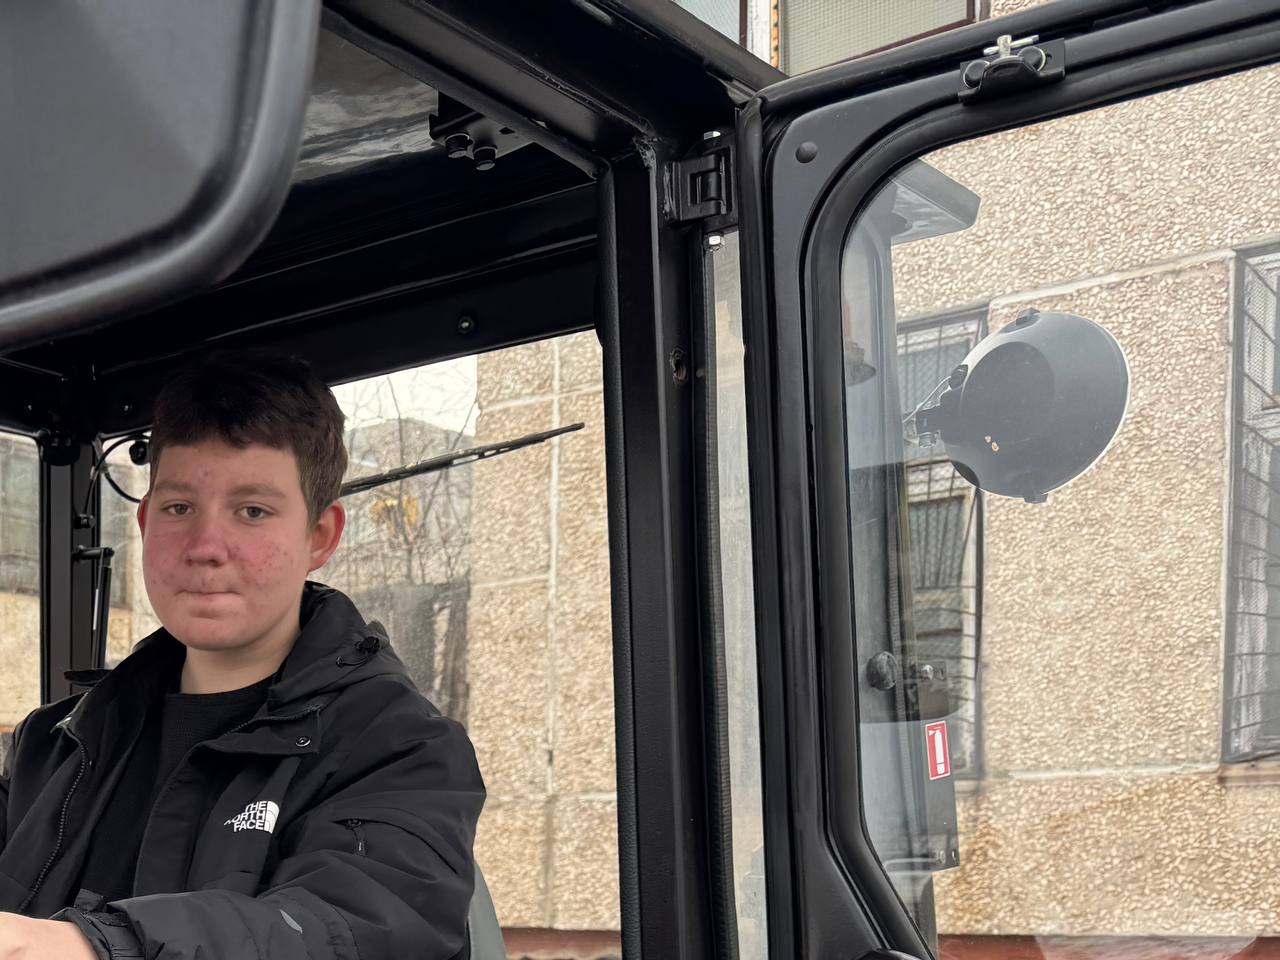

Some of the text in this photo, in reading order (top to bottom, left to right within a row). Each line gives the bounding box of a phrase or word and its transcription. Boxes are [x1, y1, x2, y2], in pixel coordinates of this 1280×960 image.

[245, 800, 267, 813] THE
[223, 810, 266, 826] NORTH
[233, 819, 264, 832] FACE
